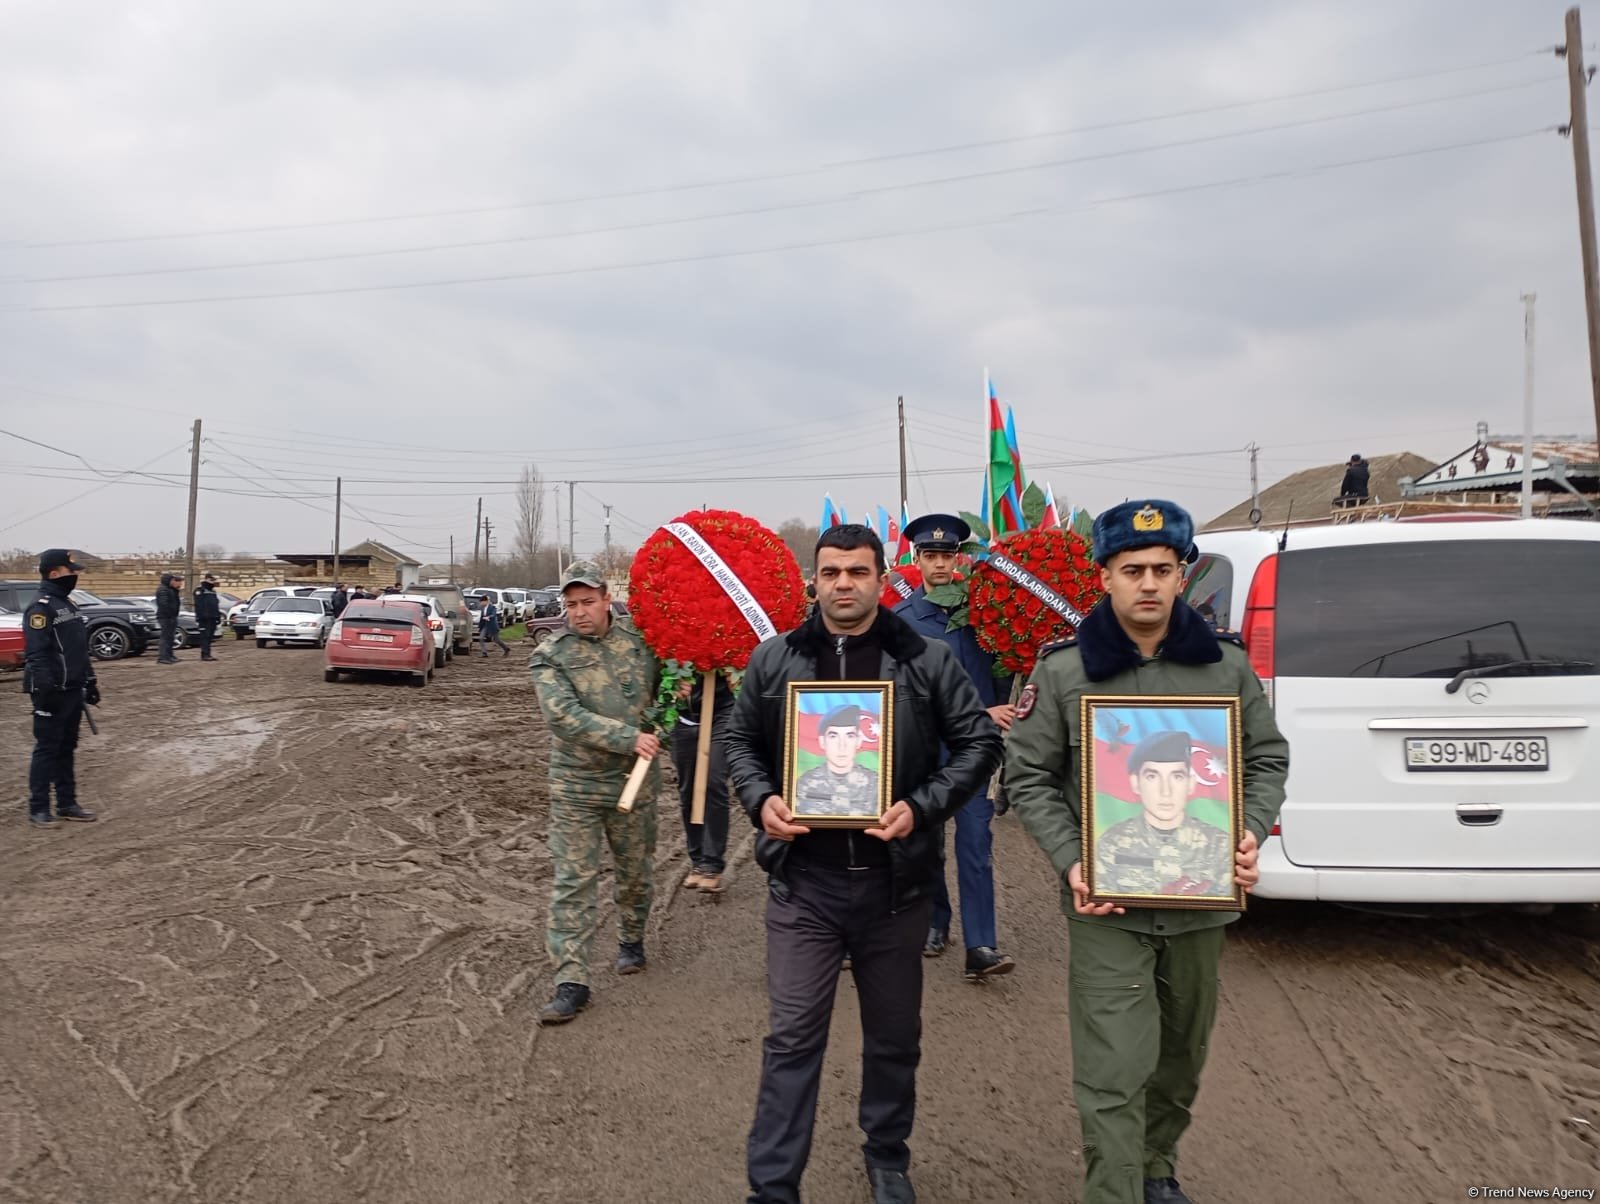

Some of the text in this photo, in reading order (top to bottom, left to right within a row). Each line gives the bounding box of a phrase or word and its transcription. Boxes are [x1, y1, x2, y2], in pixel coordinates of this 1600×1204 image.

[685, 536, 708, 556] RAYON
[743, 606, 770, 636] ADINDAN
[994, 556, 1067, 612] QARDAŞLARINDAN
[1429, 741, 1541, 764] 99-MD-488
